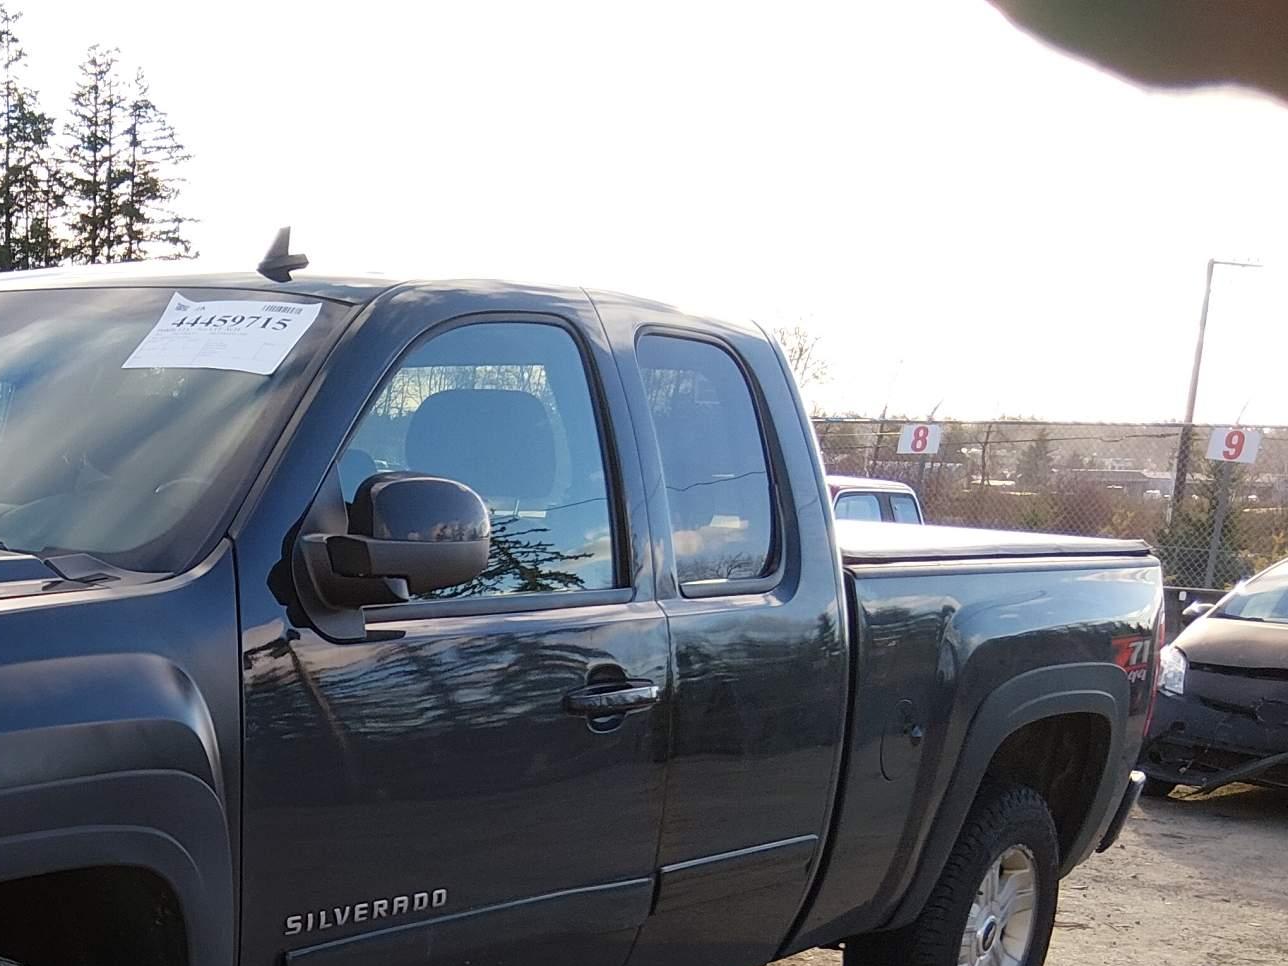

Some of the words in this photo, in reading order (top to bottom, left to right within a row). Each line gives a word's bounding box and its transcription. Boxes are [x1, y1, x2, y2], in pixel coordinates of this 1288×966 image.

[171, 314, 292, 331] 44459715
[910, 425, 929, 453] 8
[1222, 430, 1245, 460] 9
[284, 888, 448, 936] SILVERADO
